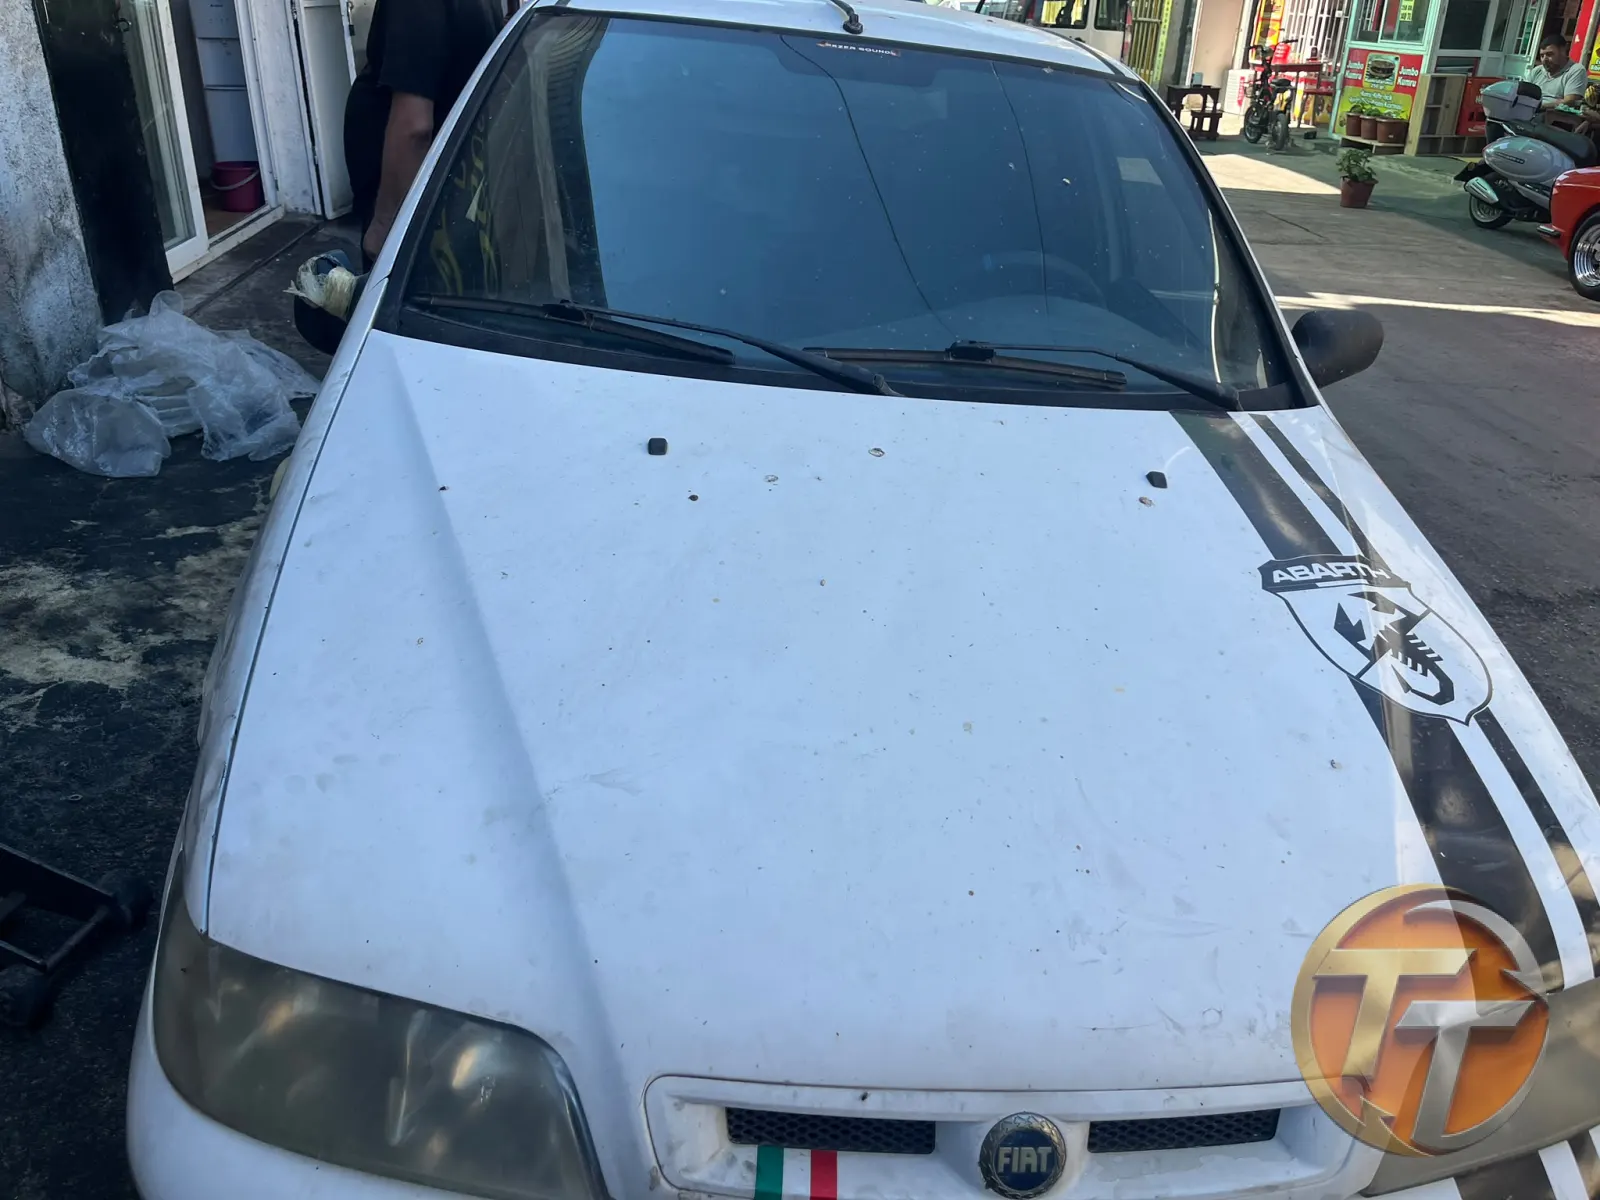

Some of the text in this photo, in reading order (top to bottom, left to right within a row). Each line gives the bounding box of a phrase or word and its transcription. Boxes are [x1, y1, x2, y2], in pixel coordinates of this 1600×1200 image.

[1346, 60, 1364, 70] Jumbo
[1399, 65, 1419, 77] Jumbo
[1397, 76, 1417, 87] Kumru
[1273, 561, 1392, 584] ABARTH
[998, 1146, 1053, 1173] FIAT
